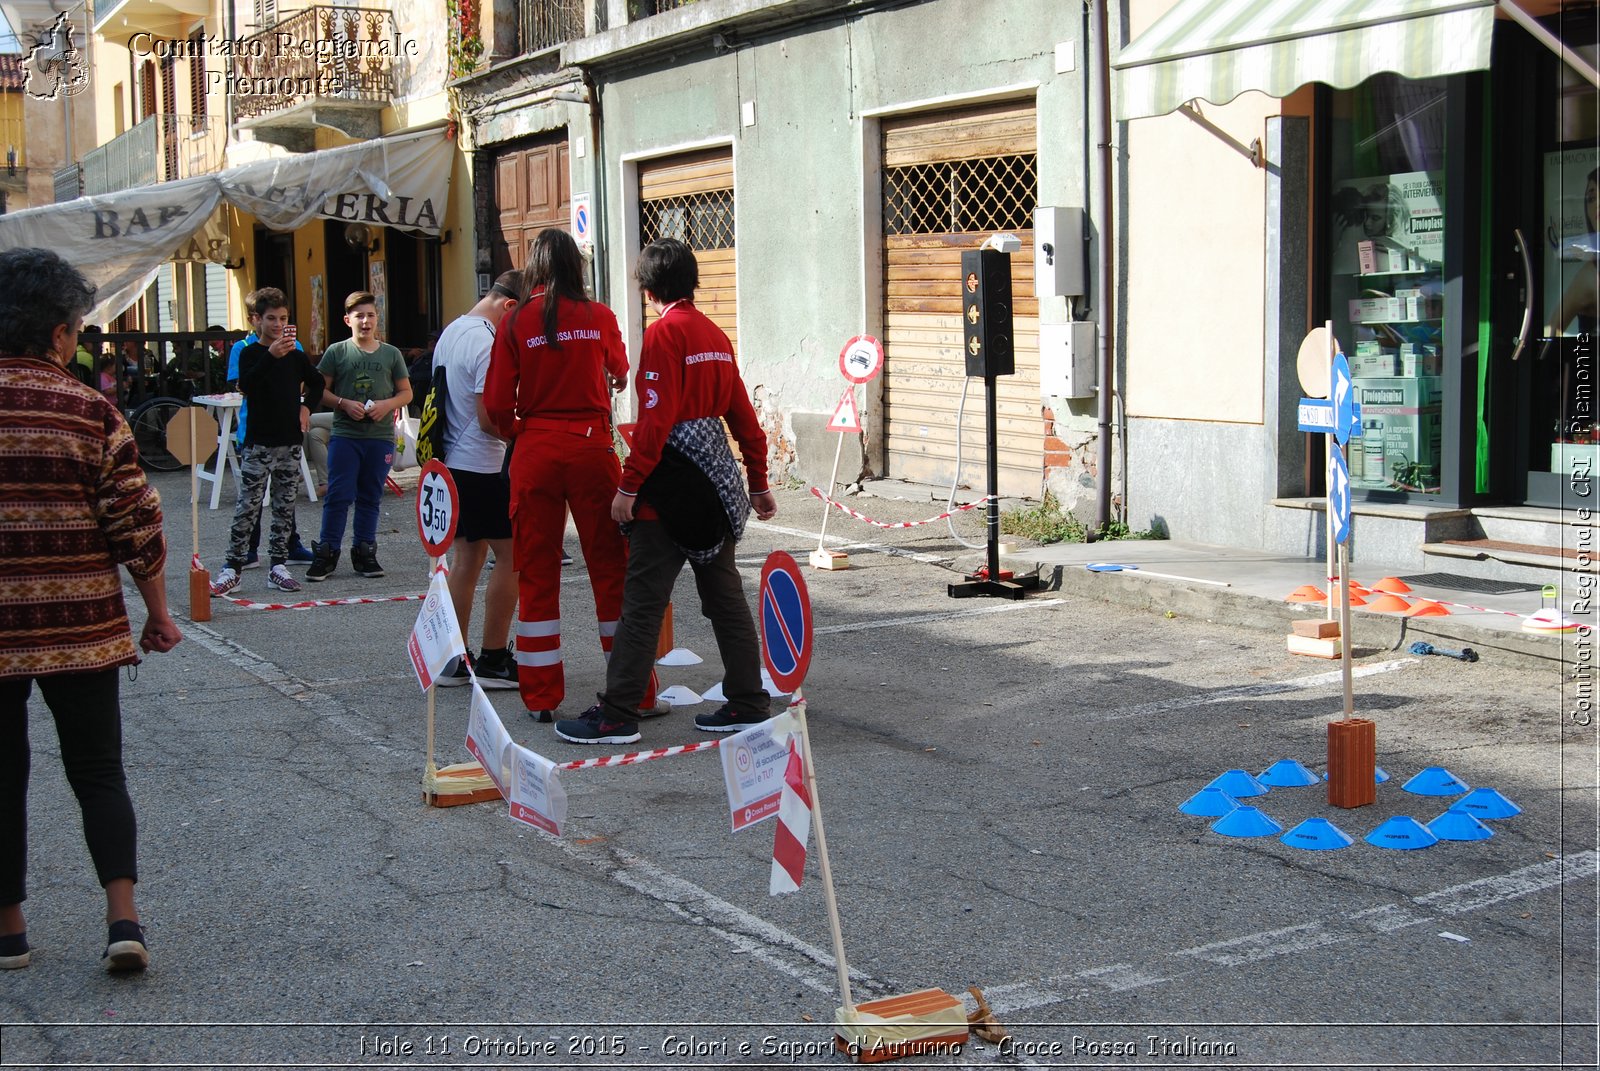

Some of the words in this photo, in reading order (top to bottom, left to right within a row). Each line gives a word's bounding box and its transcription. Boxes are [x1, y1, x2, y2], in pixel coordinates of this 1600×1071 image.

[556, 330, 572, 341] OSSA
[573, 329, 600, 341] ITALIANA
[1300, 406, 1319, 424] SENSO
[738, 754, 748, 766] 10
[762, 767, 774, 780] TU?
[751, 807, 764, 817] Croce
